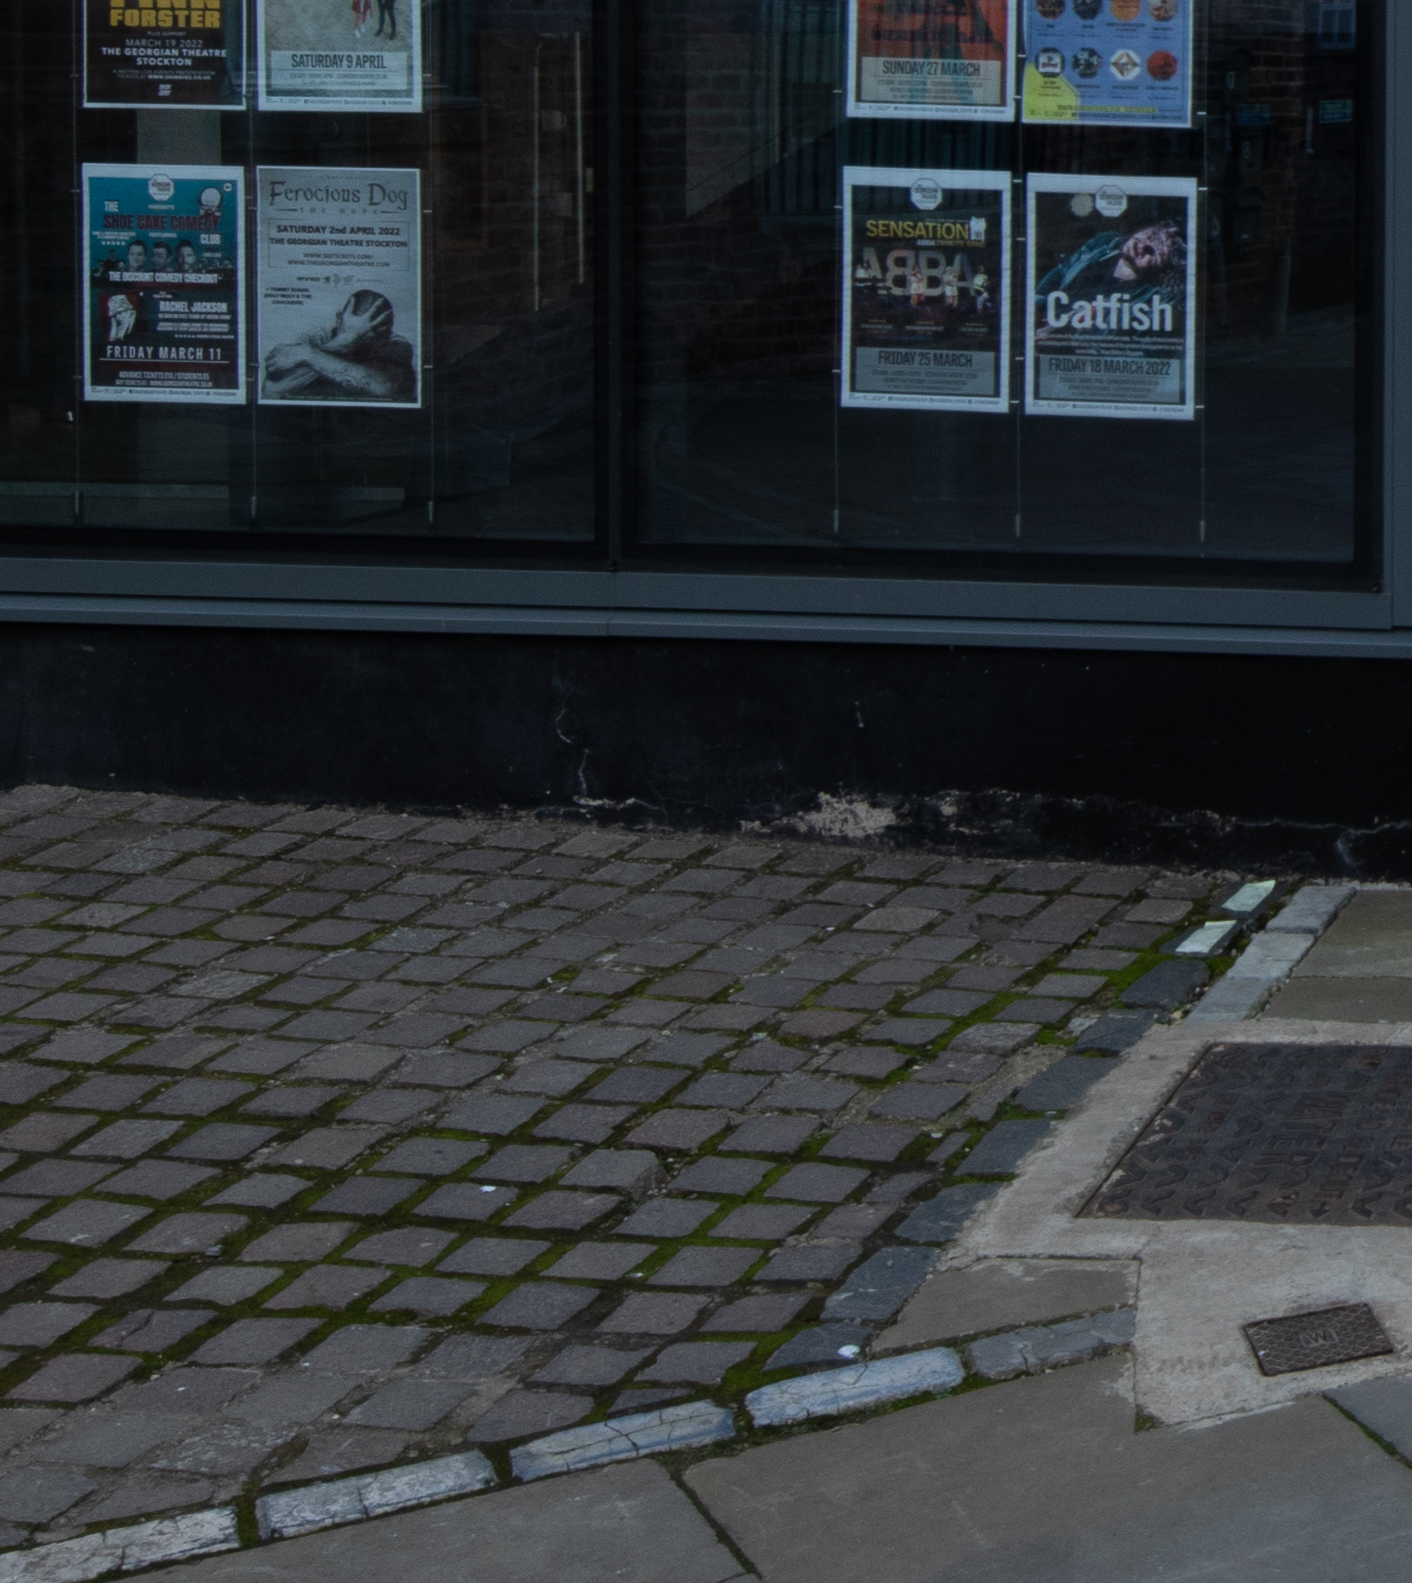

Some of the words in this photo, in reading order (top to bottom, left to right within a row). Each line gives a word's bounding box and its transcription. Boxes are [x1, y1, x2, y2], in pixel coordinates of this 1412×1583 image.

[109, 9, 221, 28] FORSTER
[125, 39, 161, 47] MARCH
[165, 39, 177, 47] 19
[179, 40, 203, 48] 2022
[101, 47, 122, 56] THE
[124, 48, 179, 56] GEORGIAN
[182, 49, 227, 57] THEATRE
[136, 57, 192, 66] STOCKTON
[291, 53, 345, 68] SATURDAY
[345, 54, 353, 68] 9
[354, 54, 388, 69] APRIL
[882, 59, 925, 75] SUNDAY
[927, 61, 939, 75] 27
[940, 62, 981, 77] MARCH
[269, 180, 361, 206] Ferocious
[368, 182, 408, 211] Dog
[104, 200, 119, 212] THE
[104, 214, 135, 230] SHOE
[137, 214, 166, 230] CAKE
[170, 215, 221, 232] COMEDY
[277, 224, 326, 234] SATURDAY
[329, 226, 347, 234] 2nd
[350, 226, 376, 235] APRIL
[378, 227, 400, 236] 2022
[866, 219, 969, 240] SENSATION
[199, 233, 221, 245] CLUB
[269, 237, 284, 245] THE
[286, 238, 328, 246] GEORGIAN
[329, 239, 363, 247] THEATRE
[365, 239, 408, 248] STOCKTON
[109, 271, 122, 282] THE
[159, 301, 190, 313] RACHEL
[190, 301, 228, 313] JACKSON
[1046, 290, 1173, 332] Catfish
[106, 345, 154, 359] FRIDAY
[159, 346, 203, 360] MARCH
[209, 347, 221, 360] 11
[877, 350, 917, 366] FRIDAY
[918, 351, 932, 366] 25
[933, 352, 973, 368] MARCH
[1049, 358, 1087, 373] FRIDAY
[1090, 358, 1102, 373] 18
[1103, 359, 1143, 374] MARCH
[1145, 361, 1171, 376] 2022
